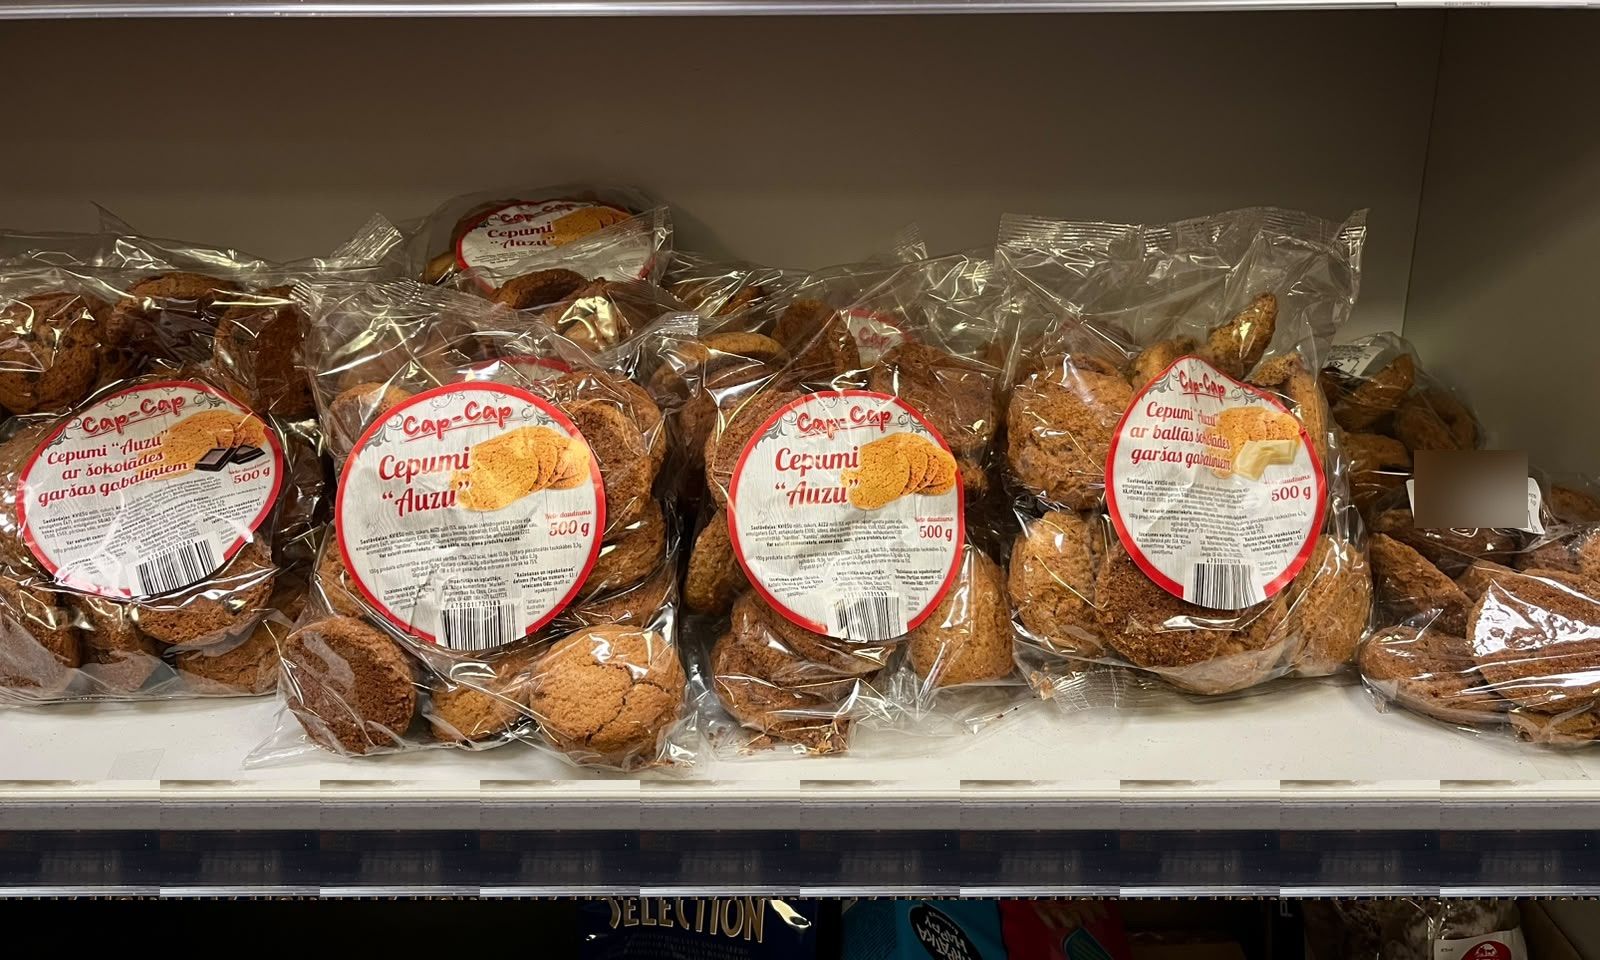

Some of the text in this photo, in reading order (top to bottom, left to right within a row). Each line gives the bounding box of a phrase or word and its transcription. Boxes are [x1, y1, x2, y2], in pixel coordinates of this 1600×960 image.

[488, 222, 553, 239] Cepumi
[82, 395, 187, 435] Cap-Cap
[403, 401, 512, 440] Cap-Cap
[1146, 401, 1194, 421] Cepumi
[796, 406, 891, 440] Cap-Cap
[1130, 427, 1148, 438] ar
[1153, 424, 1194, 441] baltās
[47, 444, 107, 466] Cepumi
[379, 446, 470, 483] Cepumi
[775, 446, 858, 477] Cepumi
[1131, 446, 1183, 468] garšas
[62, 452, 165, 481] ar šokolādes
[234, 467, 271, 484] 500 g
[38, 482, 97, 508] garšas
[100, 462, 189, 497] gabaliņiem
[1272, 486, 1311, 502] 500 g
[549, 520, 590, 536] 500 g
[919, 525, 942, 538] 500
[946, 528, 952, 541] g
[608, 898, 766, 943] SELECTION
